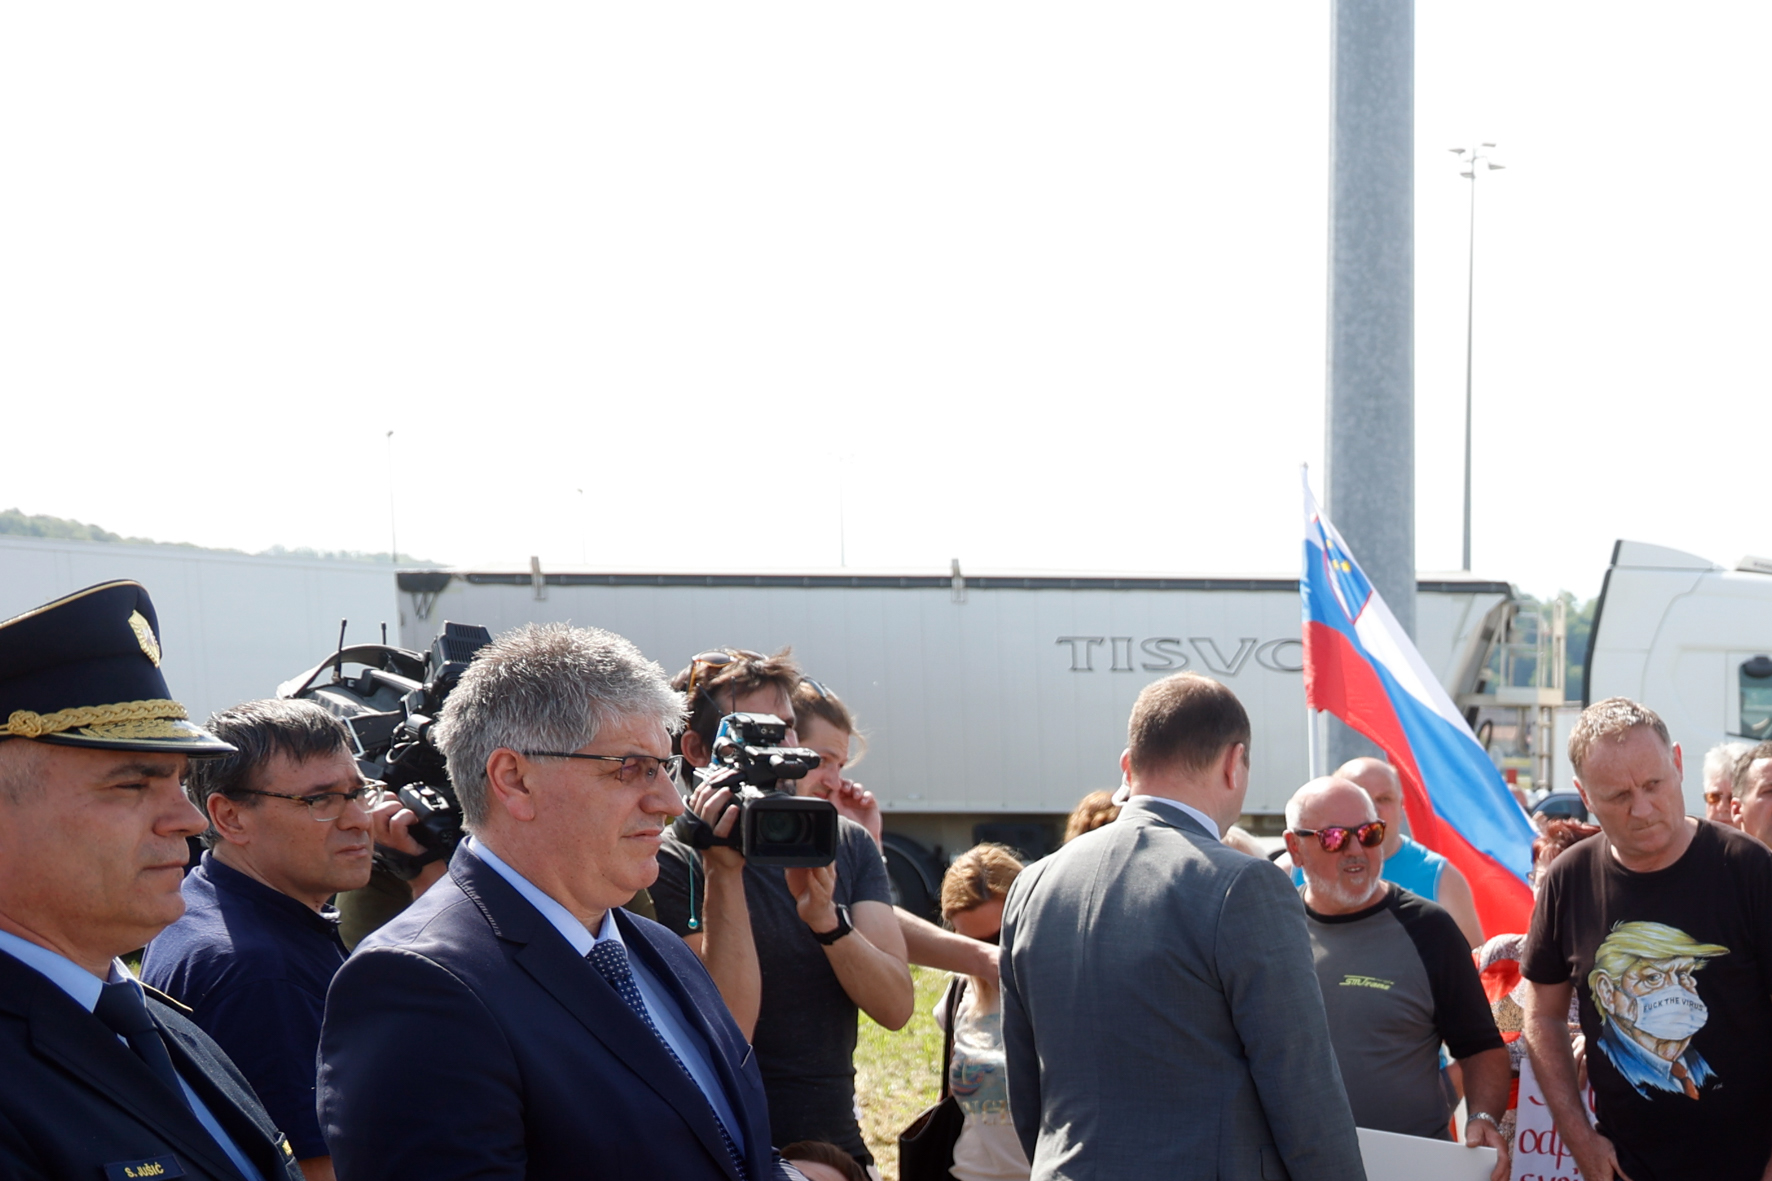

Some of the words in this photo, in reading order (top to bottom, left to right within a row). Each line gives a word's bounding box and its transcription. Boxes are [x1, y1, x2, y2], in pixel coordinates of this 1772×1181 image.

[1055, 636, 1305, 678] TISVO
[1643, 1000, 1663, 1013] FUCK
[1664, 996, 1680, 1005] THE
[1682, 998, 1703, 1011] VIRUS
